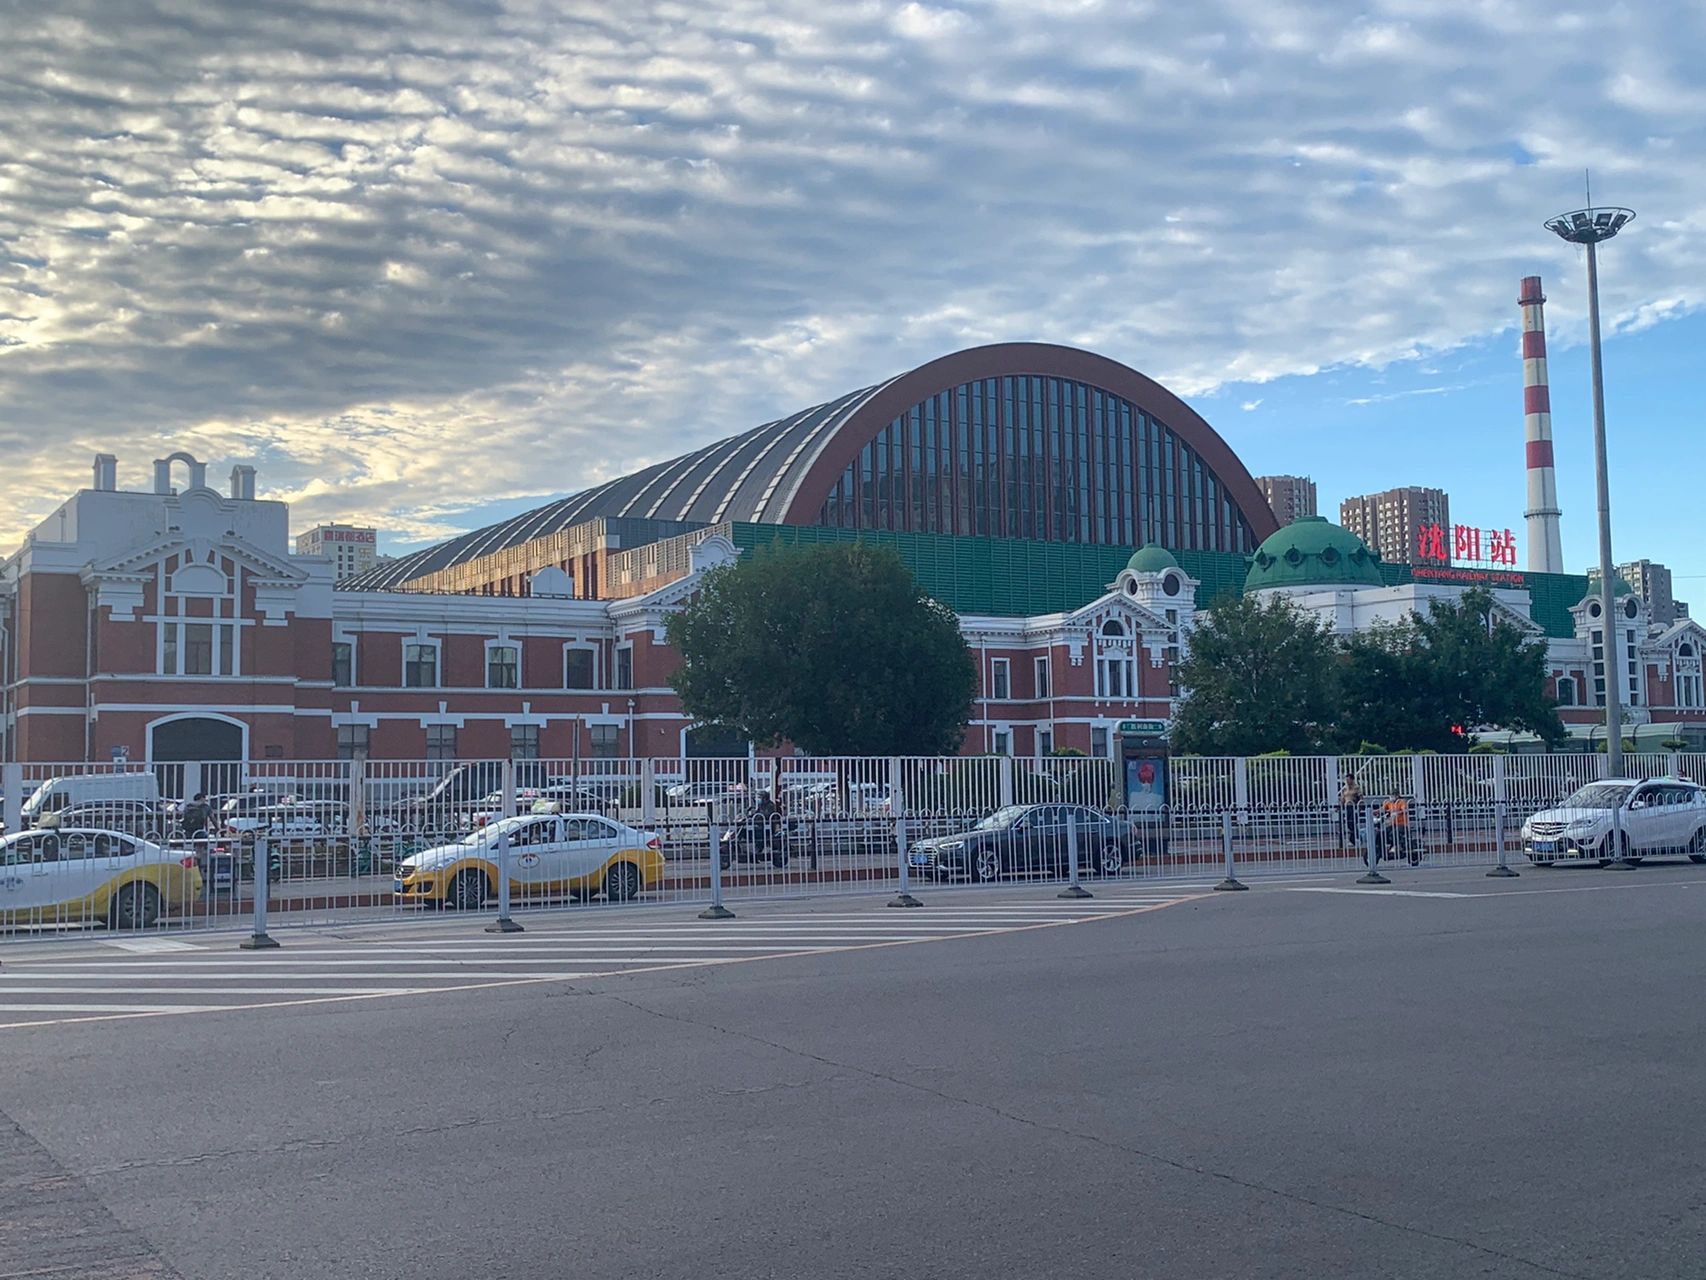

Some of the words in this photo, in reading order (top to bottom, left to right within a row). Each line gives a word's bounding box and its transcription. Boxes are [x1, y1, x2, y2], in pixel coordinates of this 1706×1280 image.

[1418, 523, 1516, 565] 沈阳站
[1456, 571, 1488, 581] RAILWAY
[1491, 572, 1524, 584] STATION
